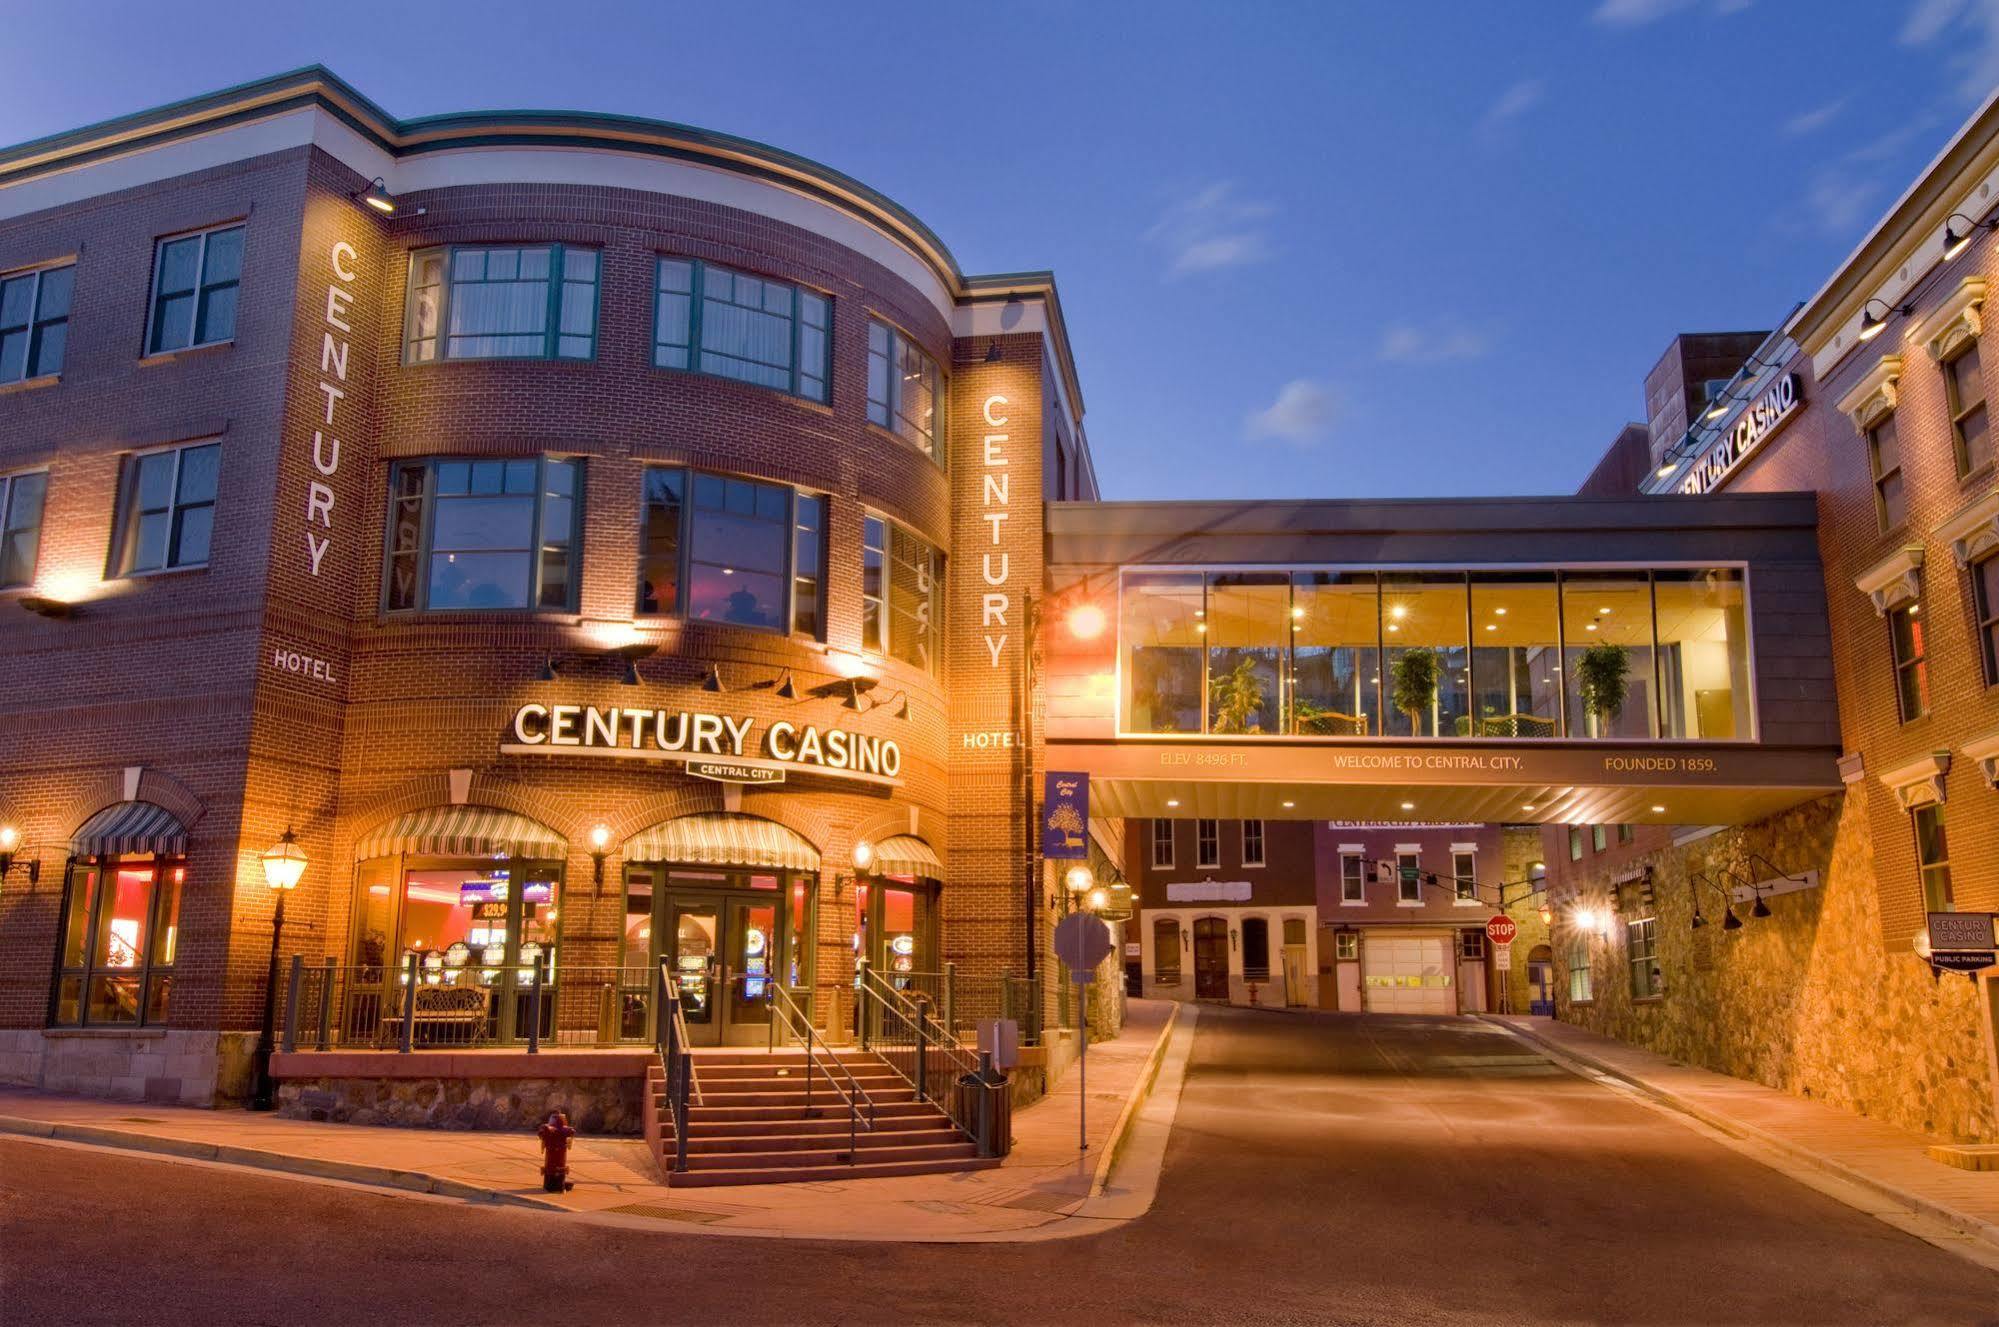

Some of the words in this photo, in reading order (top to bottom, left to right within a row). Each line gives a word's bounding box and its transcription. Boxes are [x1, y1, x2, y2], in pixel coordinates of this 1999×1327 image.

[306, 241, 358, 577] CENTURY
[1736, 375, 1794, 452] CASINO
[982, 394, 1010, 668] CENTURY
[274, 648, 337, 684] HOTEL
[514, 703, 755, 755] CENTURY
[768, 721, 901, 777] CASINO
[963, 732, 1025, 748] HOTEL
[1334, 754, 1402, 769] WELCOME
[1403, 755, 1423, 769] TO
[1426, 755, 1488, 770] CENTRAL
[1490, 756, 1524, 770] CITY.
[1605, 757, 1677, 771] FOUNDED
[1680, 758, 1717, 771] 1859.
[700, 764, 749, 777] CENTRAL
[751, 768, 774, 780] CITY
[1488, 924, 1515, 935] STOP
[1934, 920, 1987, 930] CENTURY
[1940, 931, 1985, 941] CASINO
